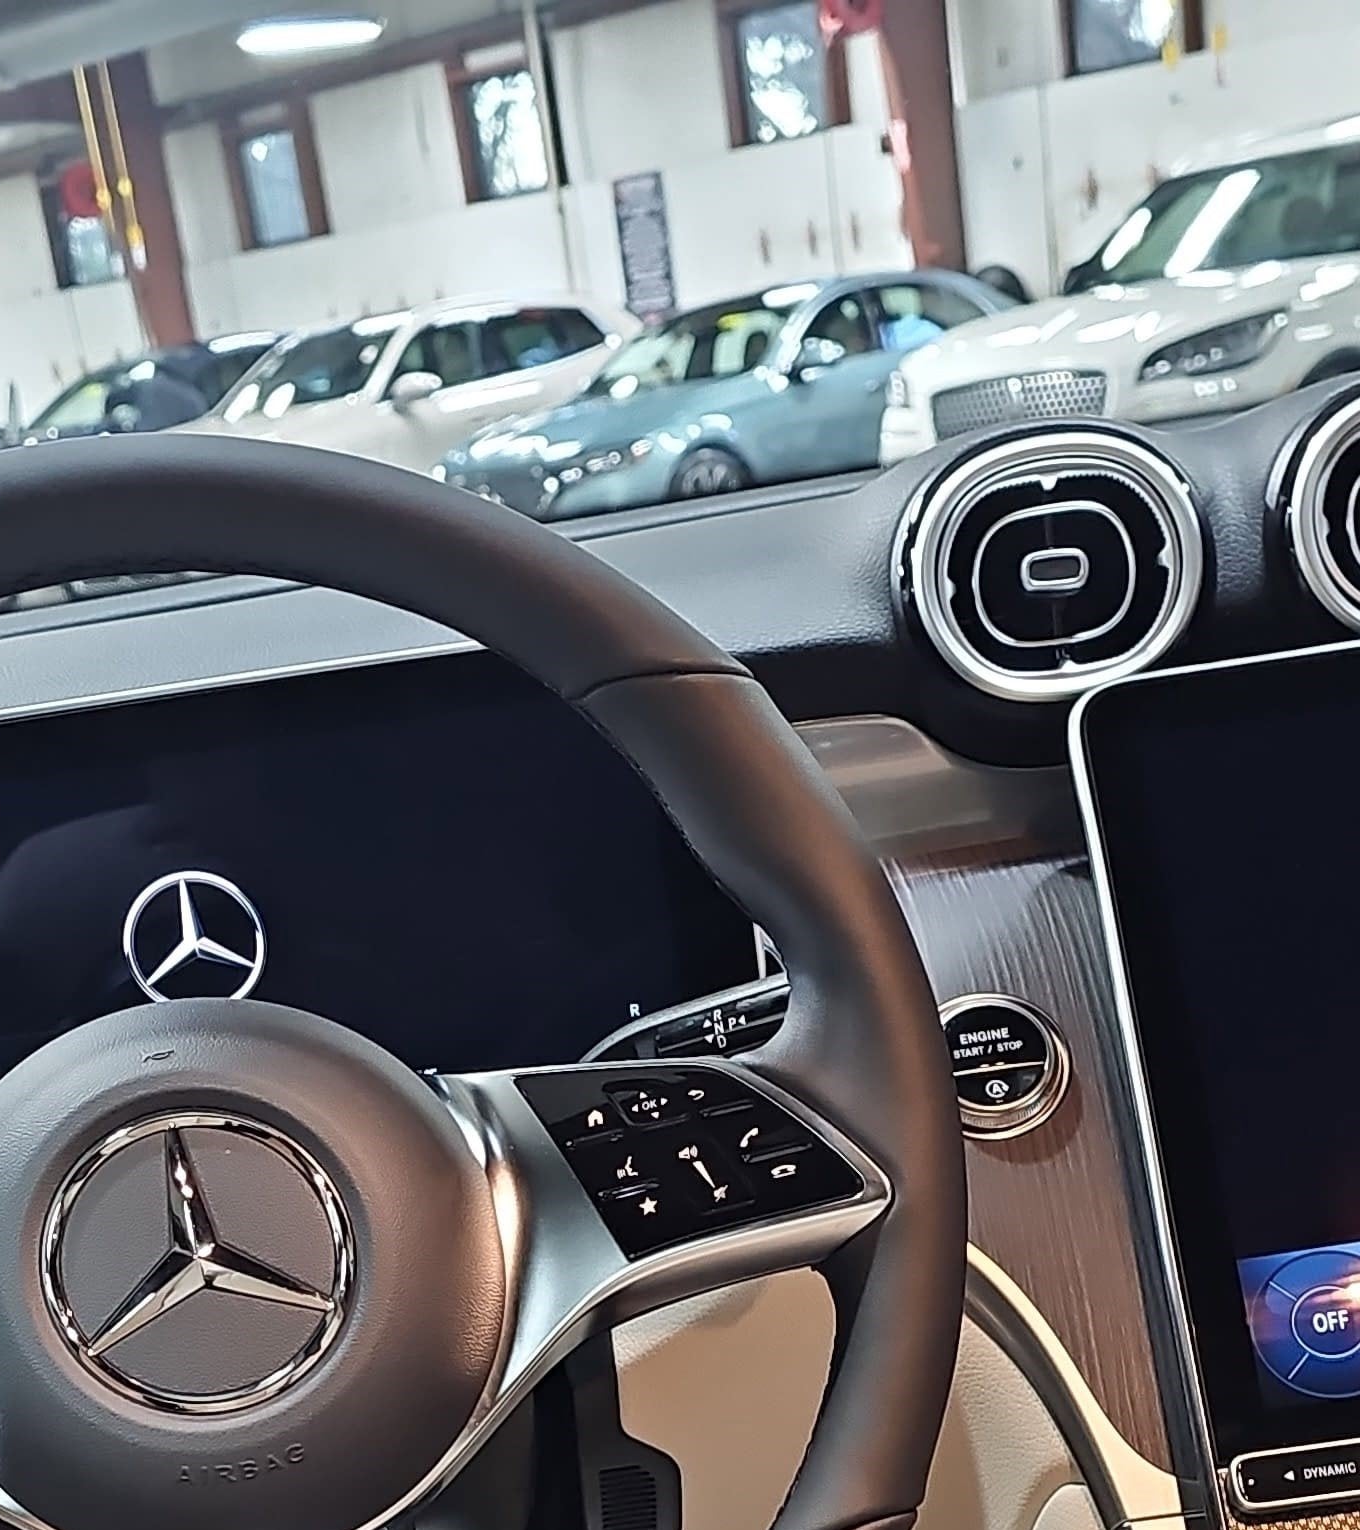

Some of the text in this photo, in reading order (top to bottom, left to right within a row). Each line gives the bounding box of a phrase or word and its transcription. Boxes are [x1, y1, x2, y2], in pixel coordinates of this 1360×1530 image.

[630, 1004, 640, 1017] R
[713, 1009, 722, 1021] R
[714, 1017, 737, 1035] N P
[717, 1035, 727, 1048] D
[959, 1027, 1010, 1045] ENGINE
[953, 1046, 984, 1059] START
[996, 1040, 1023, 1052] STOP
[641, 1099, 658, 1111] OK
[1312, 1309, 1349, 1333] OFF
[177, 1442, 305, 1486] AIRBAG
[1303, 1461, 1357, 1480] DYNAMIC
